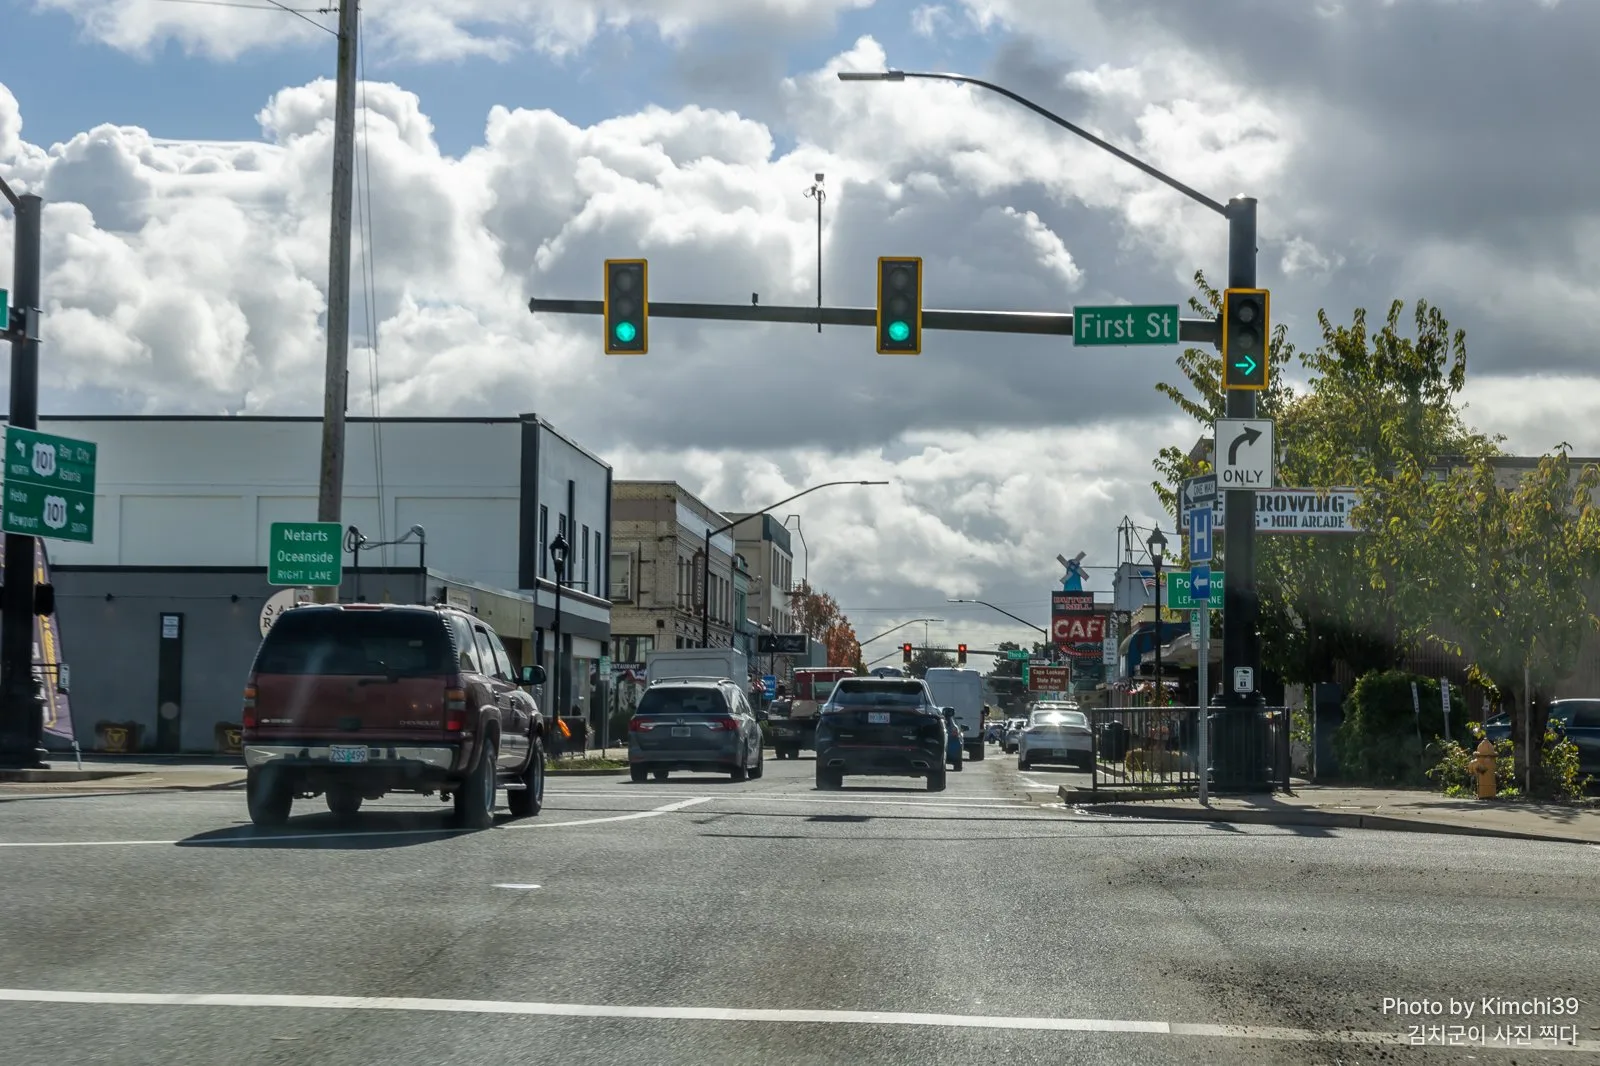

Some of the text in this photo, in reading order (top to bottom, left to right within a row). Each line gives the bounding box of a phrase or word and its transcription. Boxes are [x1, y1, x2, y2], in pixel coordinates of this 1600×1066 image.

[1081, 312, 1171, 338] First St
[36, 450, 53, 471] 101
[76, 447, 90, 464] City
[1223, 469, 1264, 484] ONLY
[1193, 481, 1215, 496] ONE WAY
[9, 511, 39, 528] Newport
[47, 502, 65, 522] 101
[1271, 514, 1298, 528] MINI
[1301, 515, 1345, 529] ARCADE
[284, 528, 329, 541] Netarts
[1193, 514, 1208, 554] H
[277, 550, 334, 563] Oceanside
[277, 569, 332, 581] RIGHT LANE
[351, 749, 365, 761] 499
